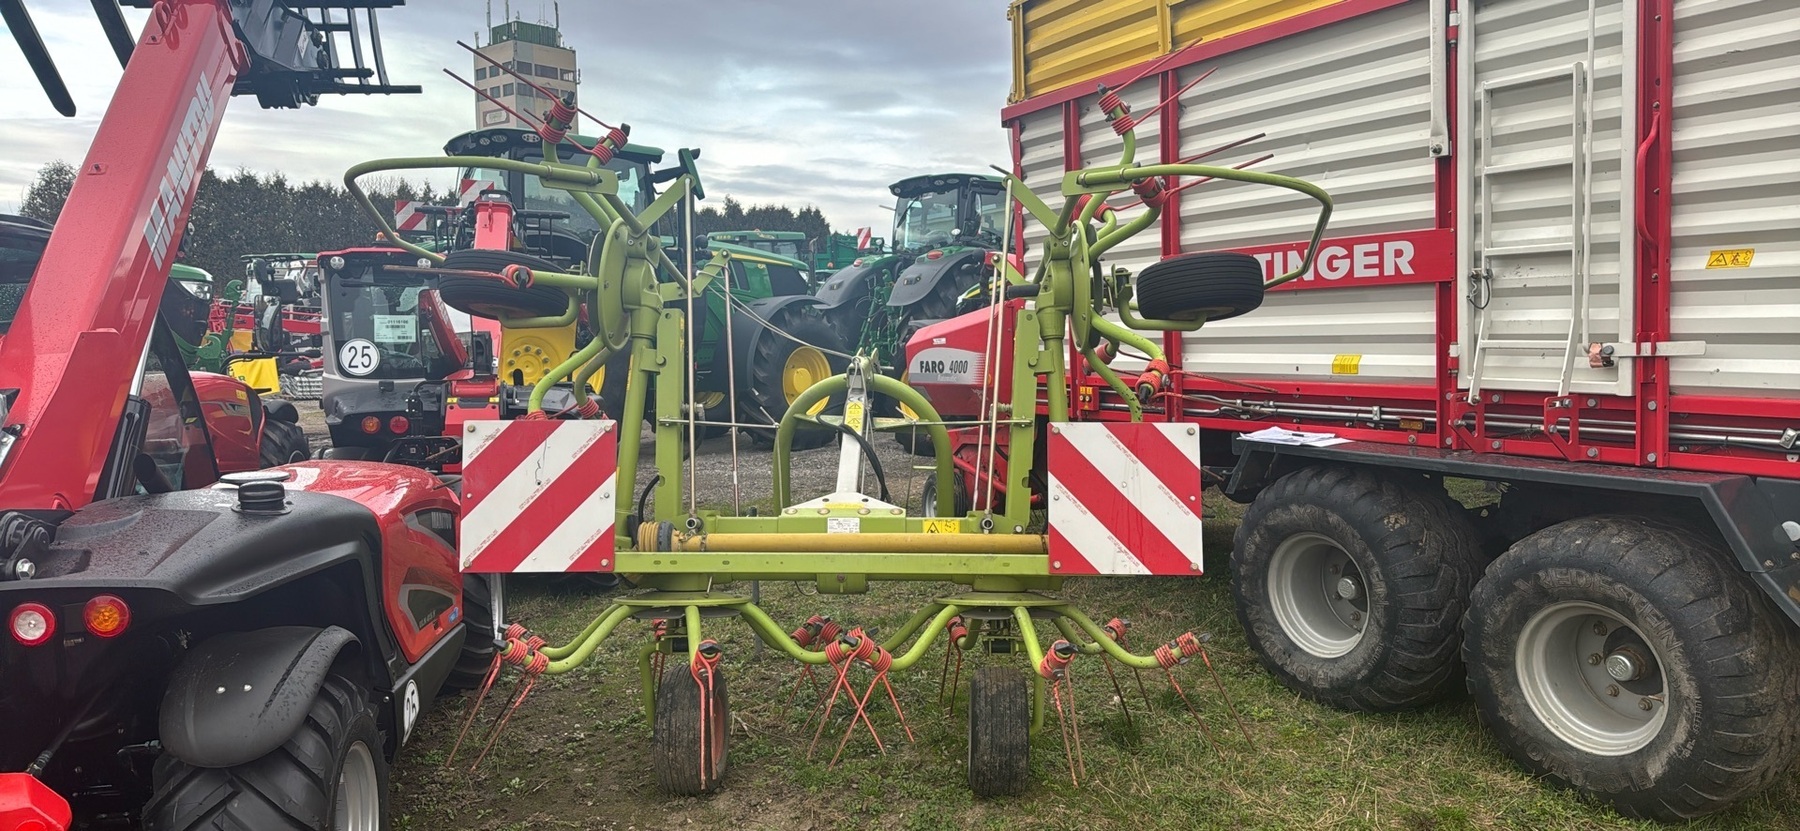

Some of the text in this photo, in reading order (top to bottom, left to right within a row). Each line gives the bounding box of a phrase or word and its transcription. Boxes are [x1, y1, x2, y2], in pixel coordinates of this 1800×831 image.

[143, 71, 215, 271] MANITOU
[348, 345, 372, 369] 25
[920, 360, 969, 374] FARO 4000
